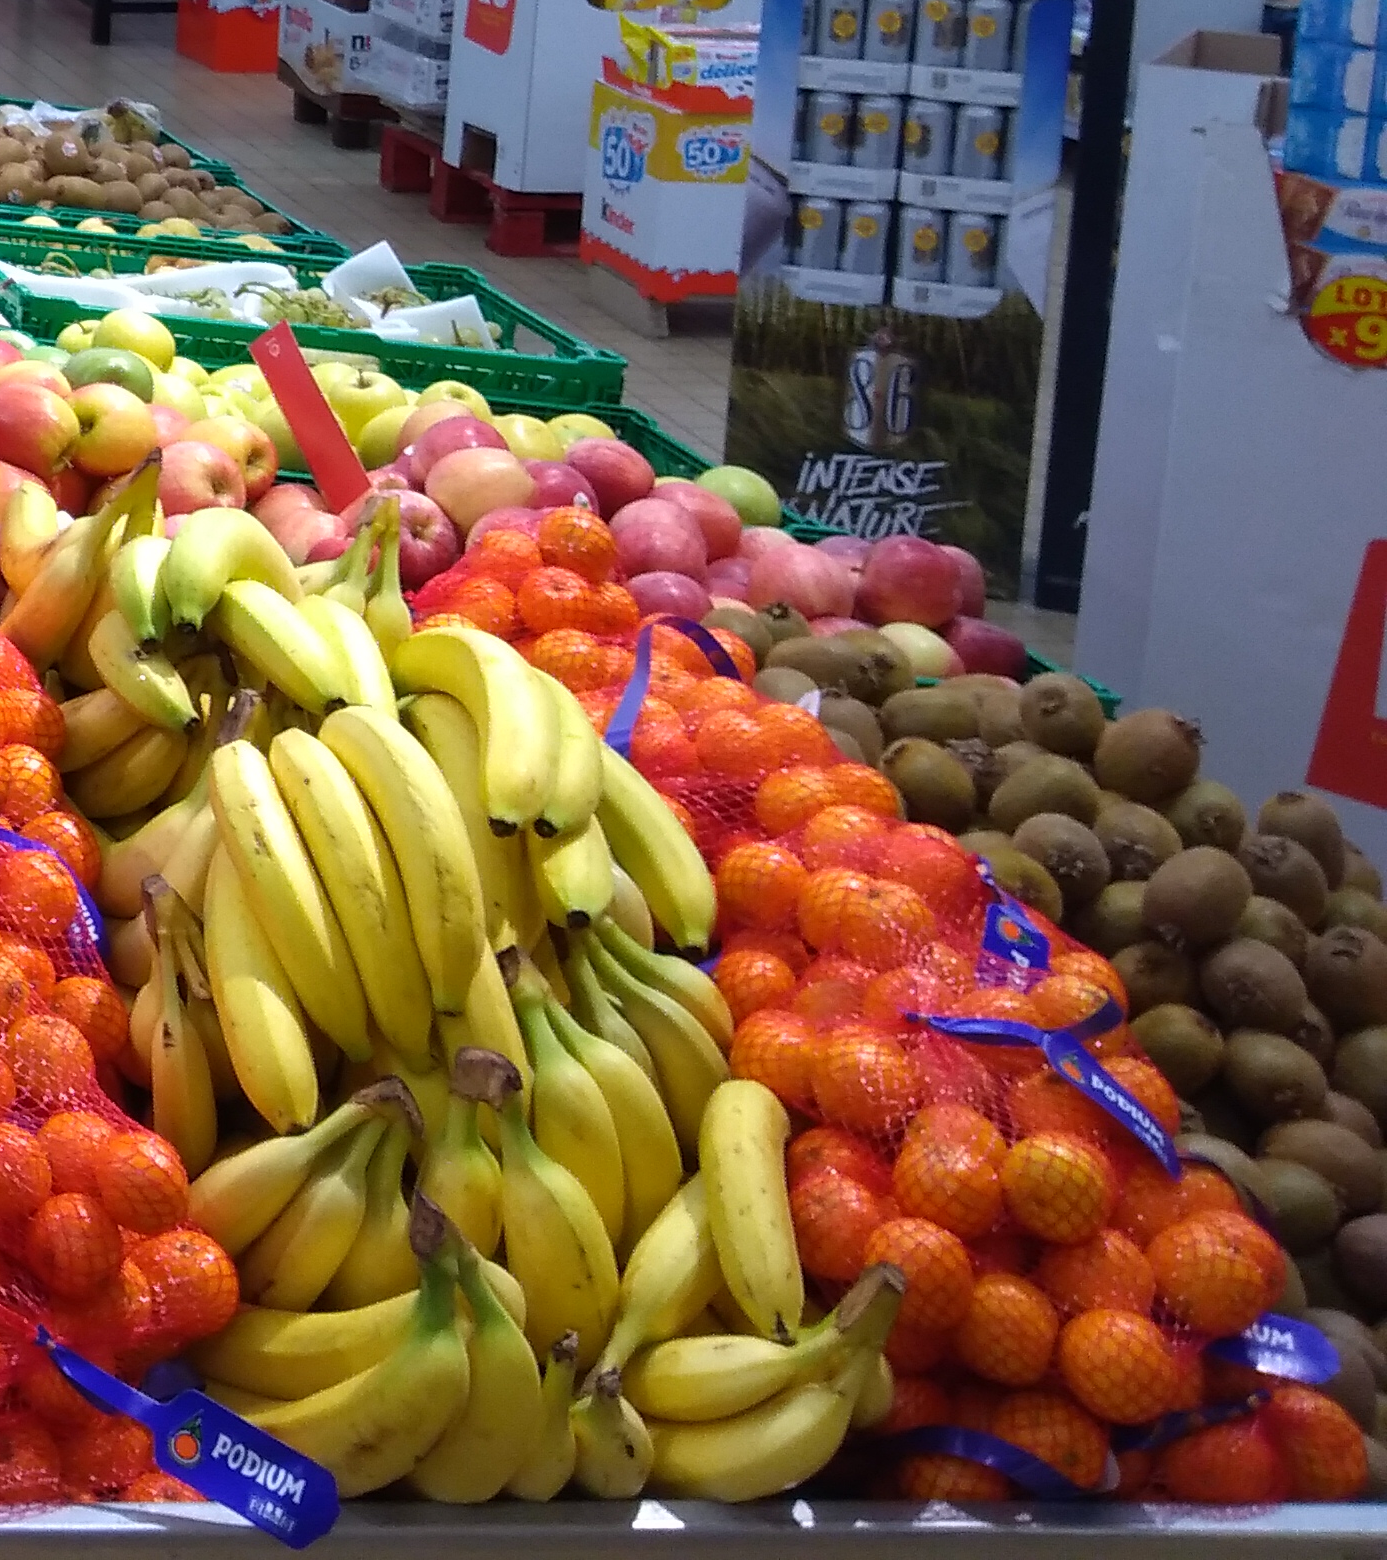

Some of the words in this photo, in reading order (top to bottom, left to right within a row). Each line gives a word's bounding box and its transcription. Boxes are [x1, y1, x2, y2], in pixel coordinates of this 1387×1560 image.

[603, 135, 631, 178] 50
[687, 141, 721, 165] 50
[1090, 1071, 1166, 1147] PODIUM
[210, 1431, 307, 1505] PODIUM
